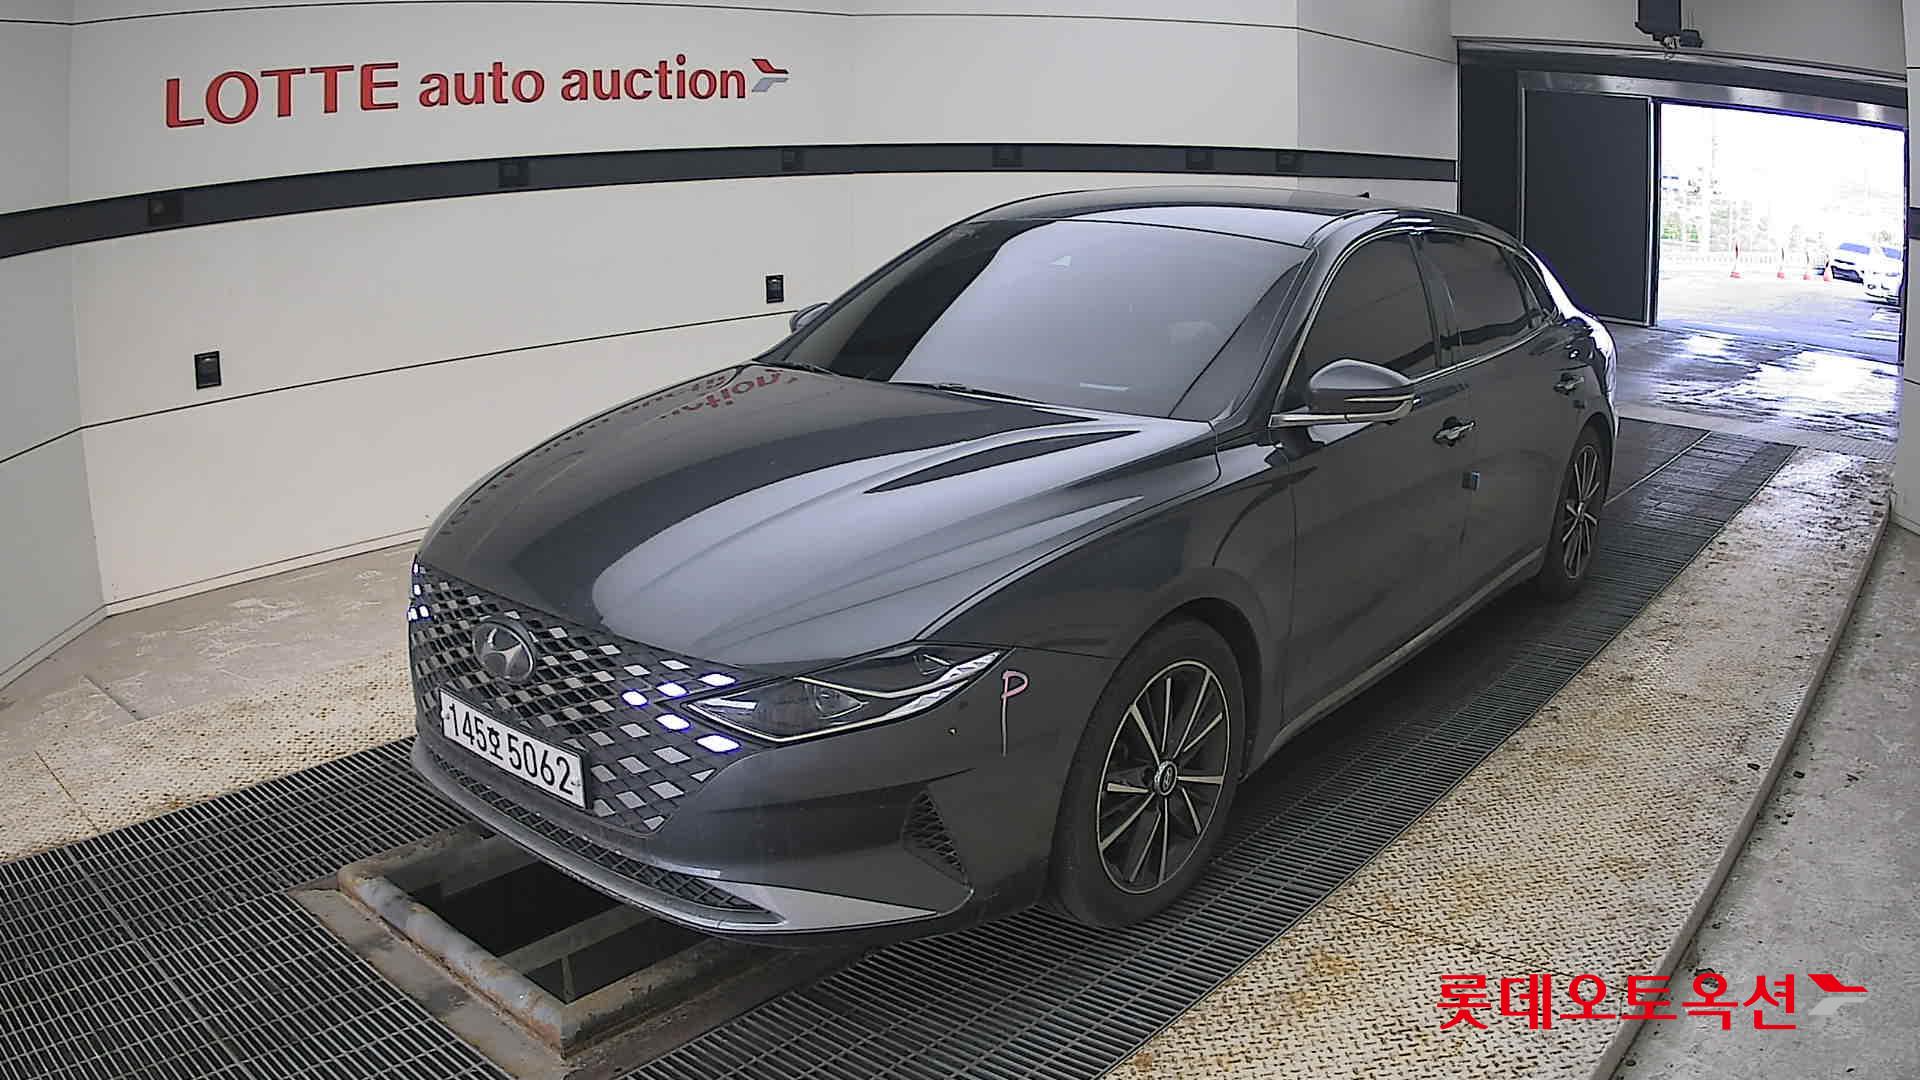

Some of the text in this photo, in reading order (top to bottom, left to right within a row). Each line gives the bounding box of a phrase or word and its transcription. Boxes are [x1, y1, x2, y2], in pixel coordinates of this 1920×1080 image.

[165, 54, 748, 129] LOTTE auto auction
[449, 702, 574, 796] 145호 5062
[1001, 670, 1029, 757] P
